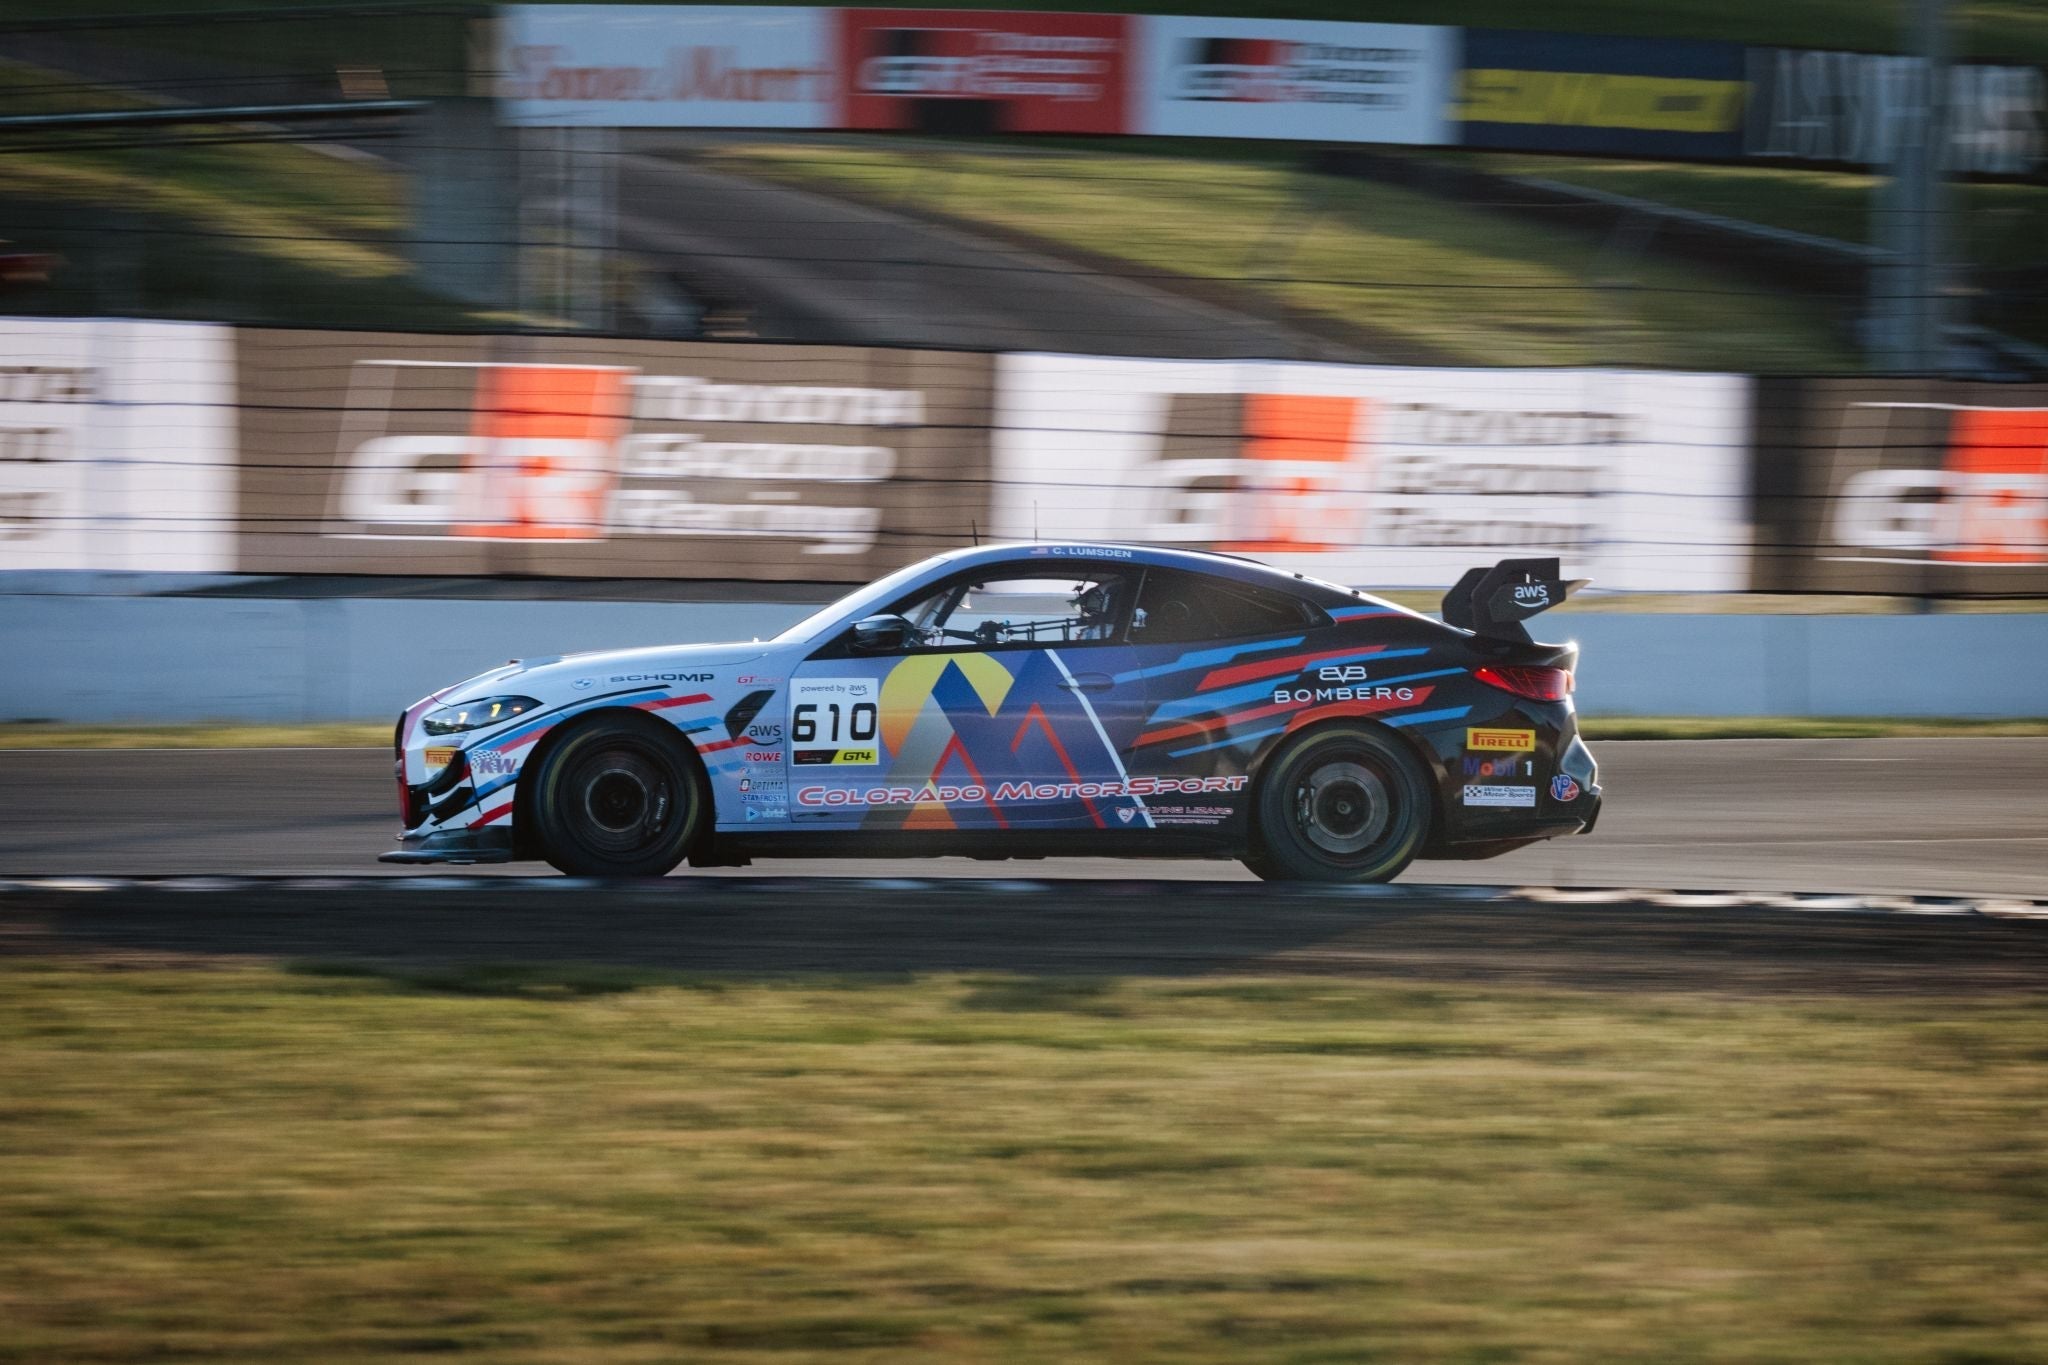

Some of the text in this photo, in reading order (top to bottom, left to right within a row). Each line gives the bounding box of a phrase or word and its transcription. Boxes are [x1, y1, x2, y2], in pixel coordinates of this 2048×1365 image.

[1052, 547, 1132, 558] C. LUMSDEN
[610, 673, 715, 682] SCHOMP
[1274, 687, 1414, 704] BOMBERG
[792, 703, 877, 742] 610
[1472, 732, 1530, 747] PIRELLI
[745, 752, 782, 761] ROWE
[843, 752, 872, 761] GT4
[479, 758, 517, 774] KW
[1463, 758, 1532, 776] Mobil 1
